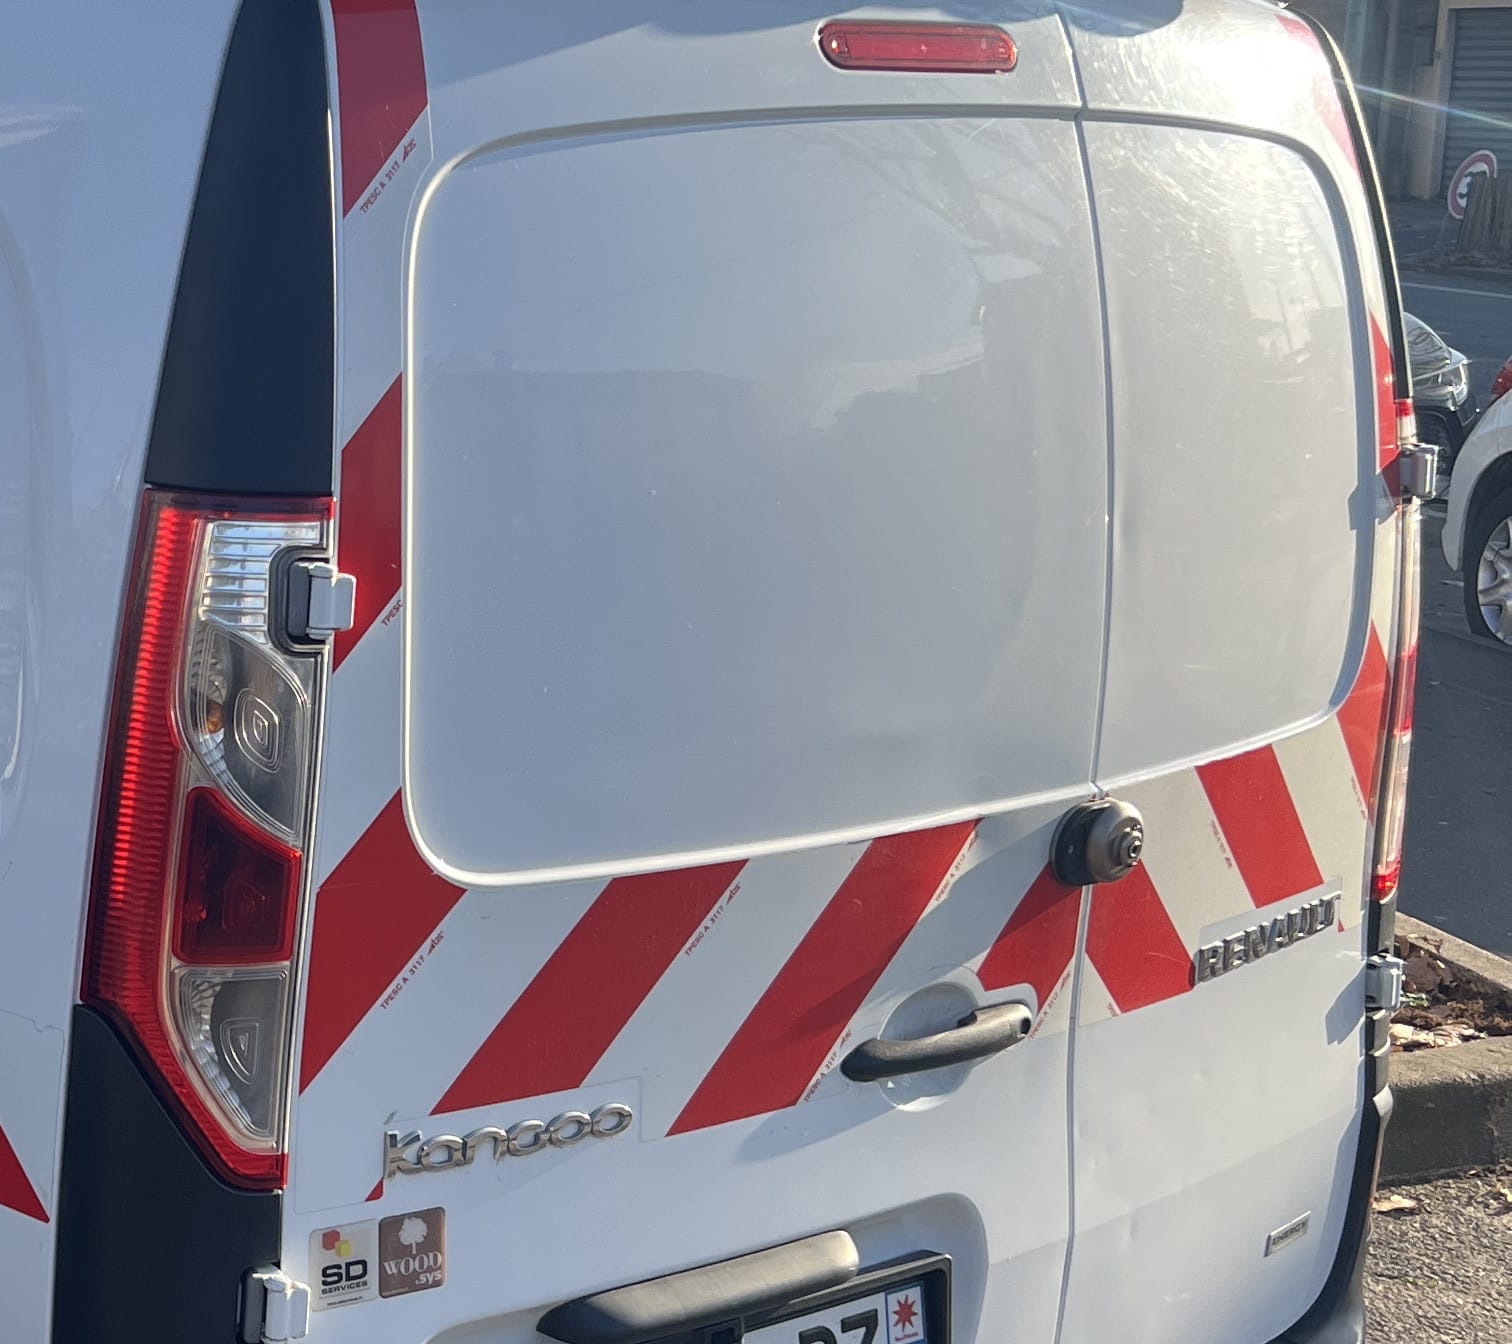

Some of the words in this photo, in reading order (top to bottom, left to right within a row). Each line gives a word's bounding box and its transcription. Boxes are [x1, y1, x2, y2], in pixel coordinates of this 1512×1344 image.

[1197, 890, 1342, 982] RENAULT
[380, 983, 403, 1009] TPESC
[408, 955, 425, 975] 3117
[321, 1259, 368, 1287] SD
[383, 1251, 442, 1276] WOOD
[415, 1270, 442, 1285] .sys
